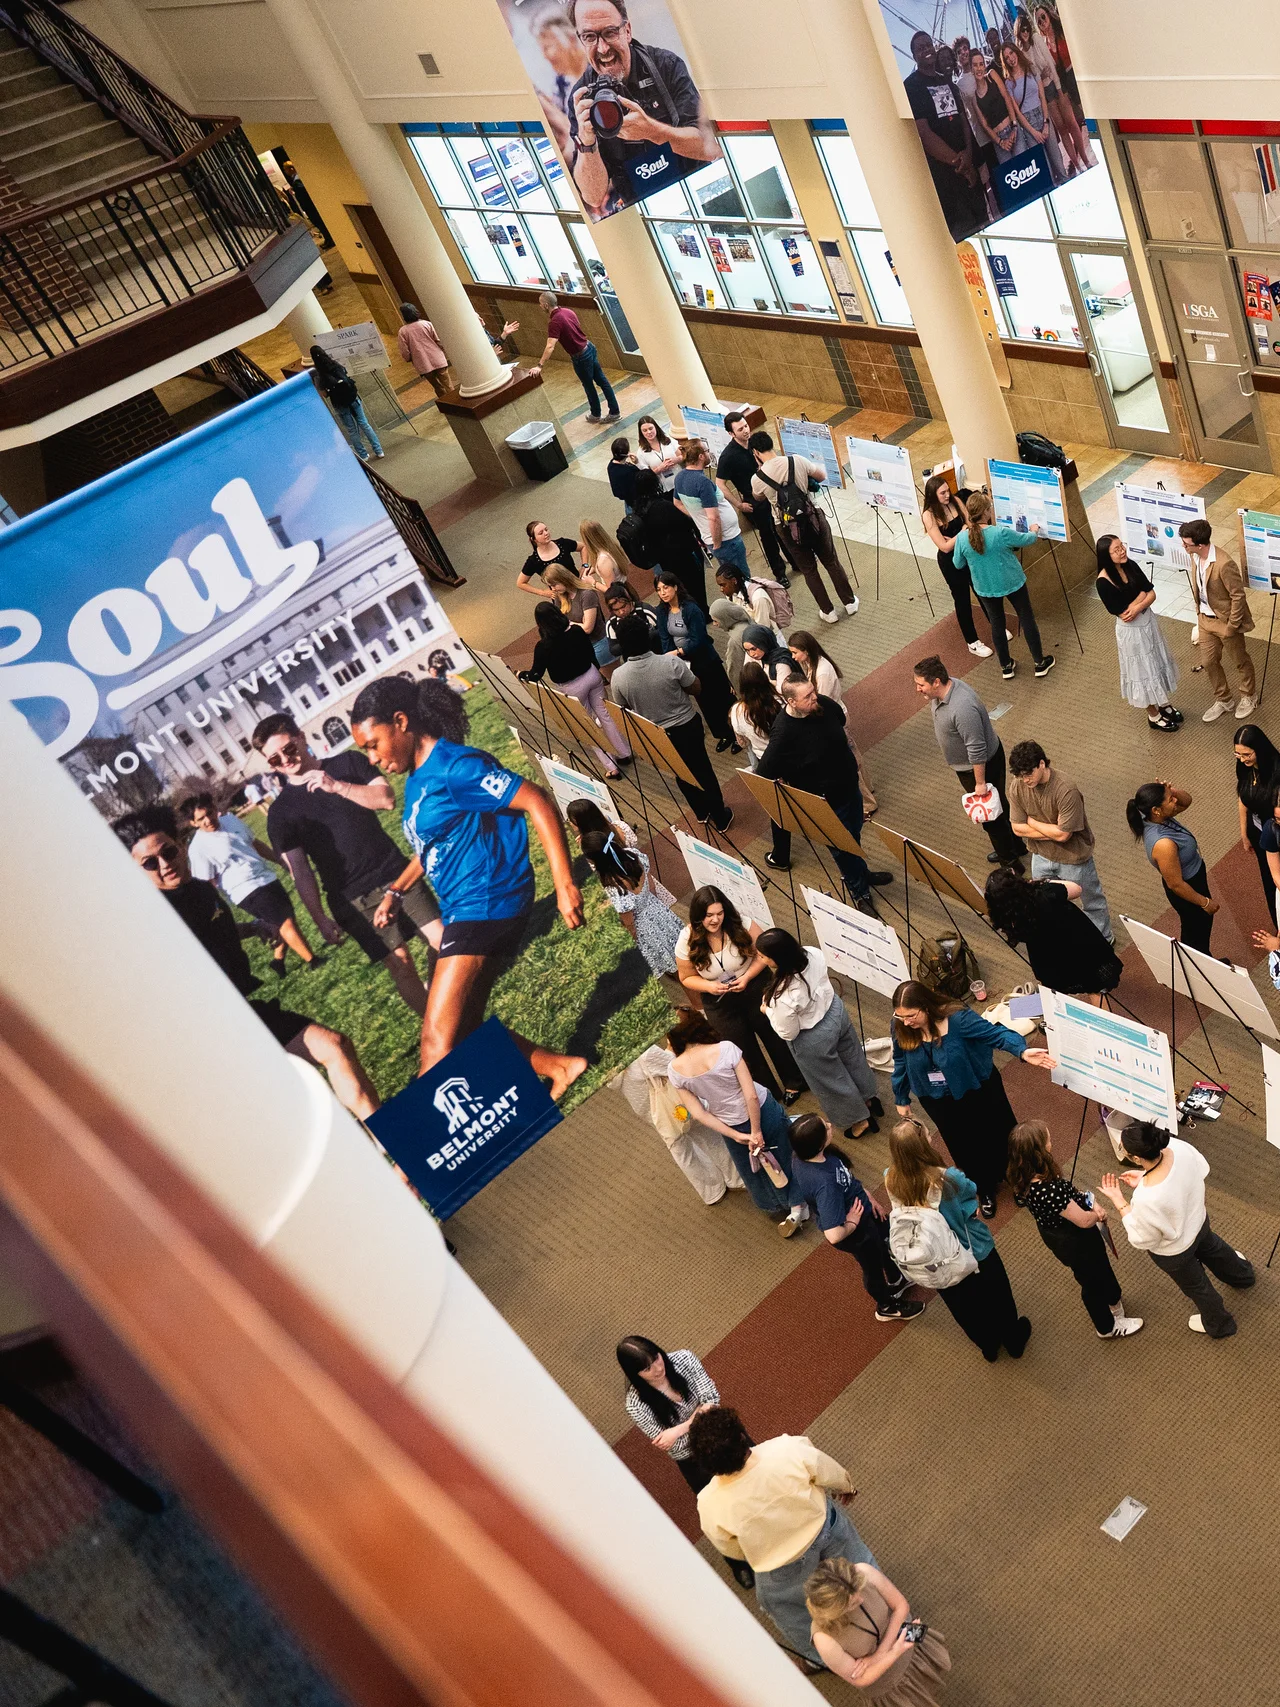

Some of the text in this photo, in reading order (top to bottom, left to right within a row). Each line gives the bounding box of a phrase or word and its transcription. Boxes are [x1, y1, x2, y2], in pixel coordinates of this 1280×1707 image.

[635, 154, 669, 179] Soul
[1005, 159, 1040, 189] Soul
[0, 478, 320, 757] Soul
[186, 608, 357, 729] UNIVERSITY
[426, 1085, 519, 1170] BELMONT
[446, 1106, 518, 1171] UNIVERSITY
